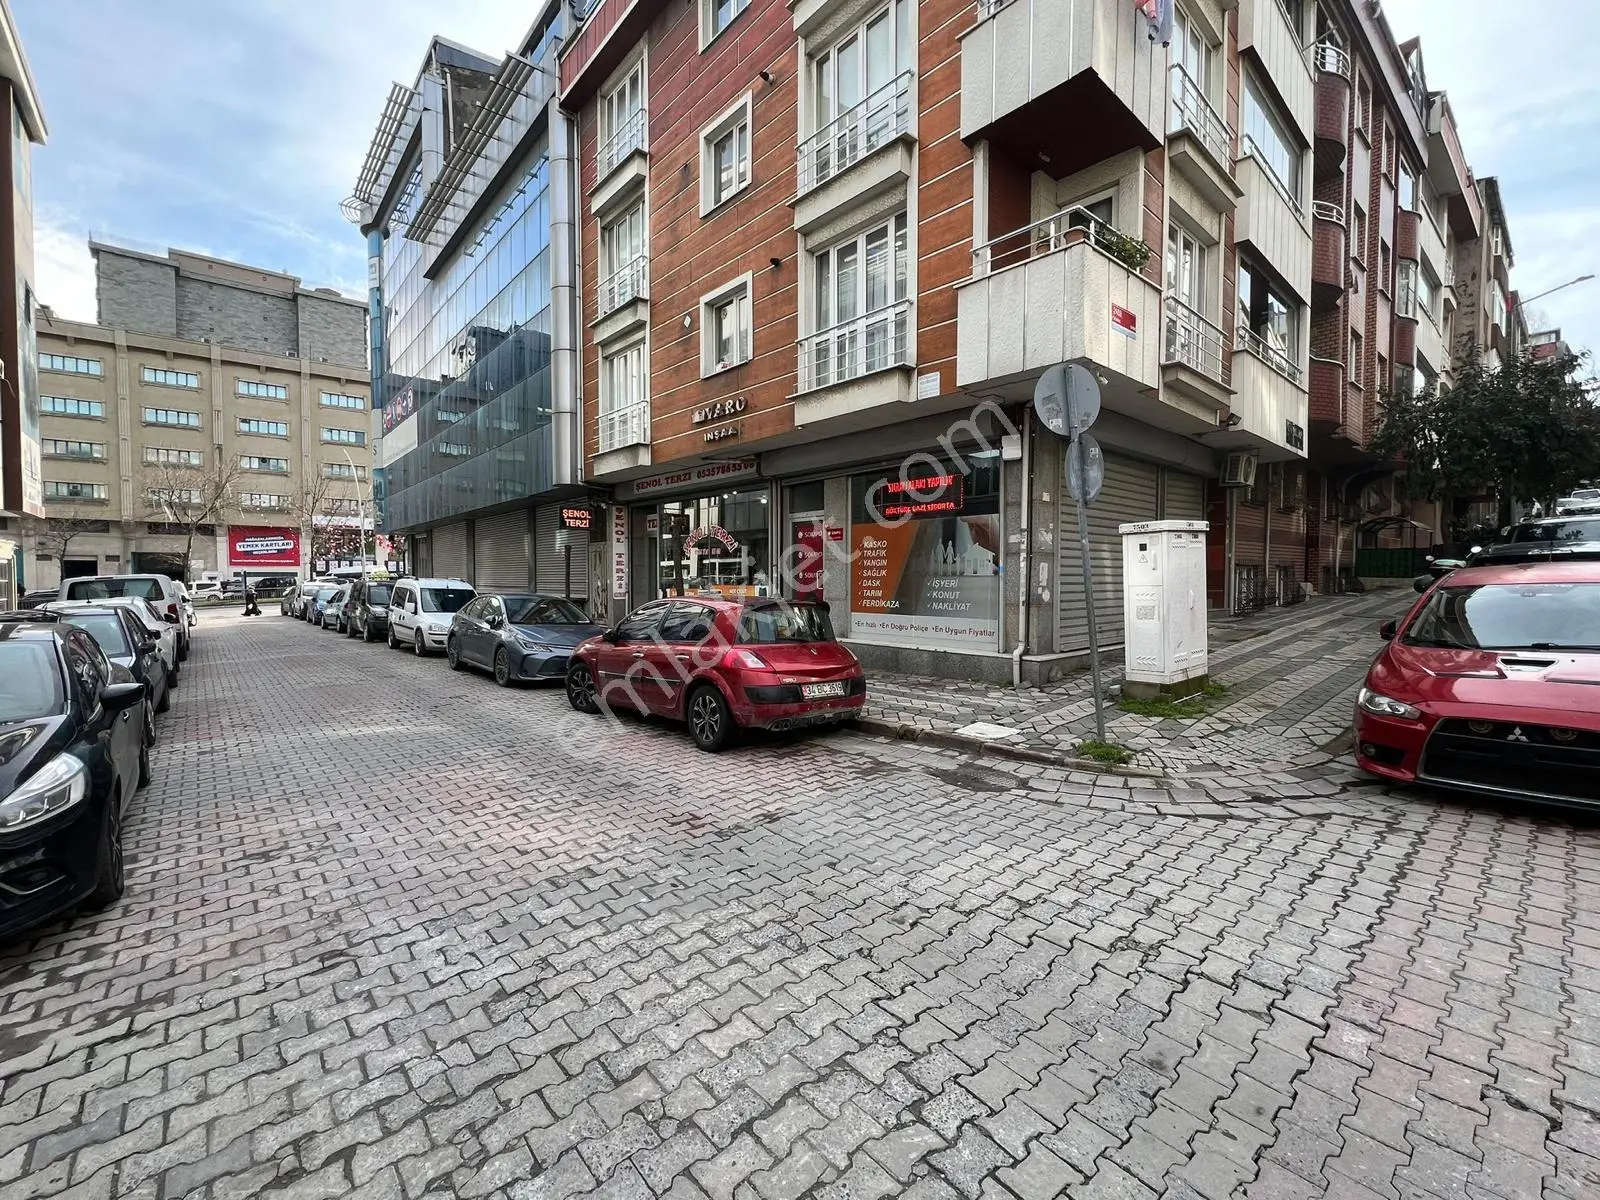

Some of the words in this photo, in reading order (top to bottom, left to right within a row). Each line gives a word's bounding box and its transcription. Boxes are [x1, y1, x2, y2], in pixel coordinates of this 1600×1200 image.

[562, 509, 592, 519] ŞENOL
[565, 518, 589, 528] TERZİ
[863, 540, 888, 548] KASKO
[863, 559, 888, 567] YANGIN
[862, 567, 888, 577] SAĞLIK
[862, 579, 881, 587] DASK
[932, 577, 960, 589] İŞYERİ
[863, 589, 883, 597] TARIM
[932, 591, 960, 600] KONUT
[945, 626, 967, 635] Uygun
[968, 628, 996, 637] Fiyatlar
[807, 685, 816, 695] 34
